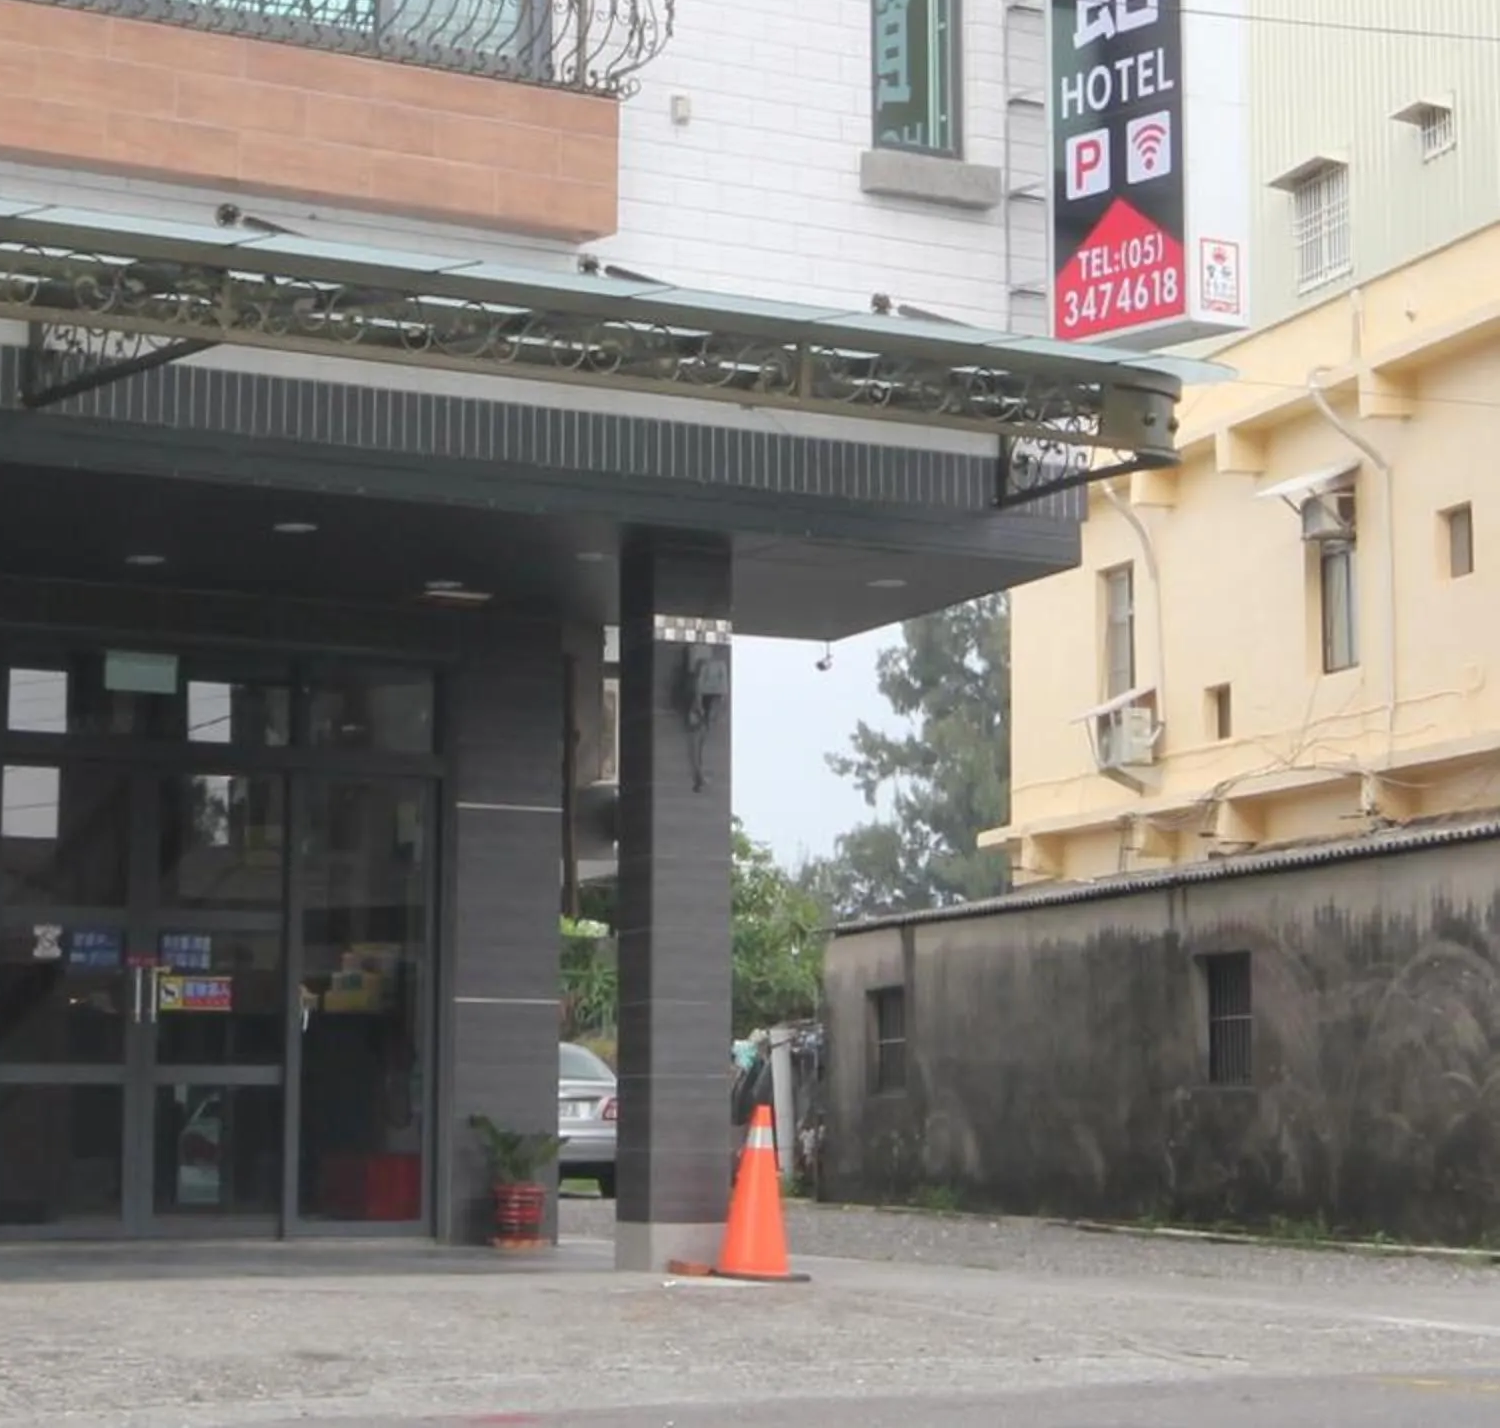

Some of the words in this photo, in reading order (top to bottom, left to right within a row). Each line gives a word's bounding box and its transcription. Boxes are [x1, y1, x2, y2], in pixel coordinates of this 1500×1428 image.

[1061, 47, 1174, 119] HOTEL
[1075, 138, 1101, 191] P
[1078, 231, 1163, 281] TEL:(05)
[1064, 267, 1178, 327] 3474618
